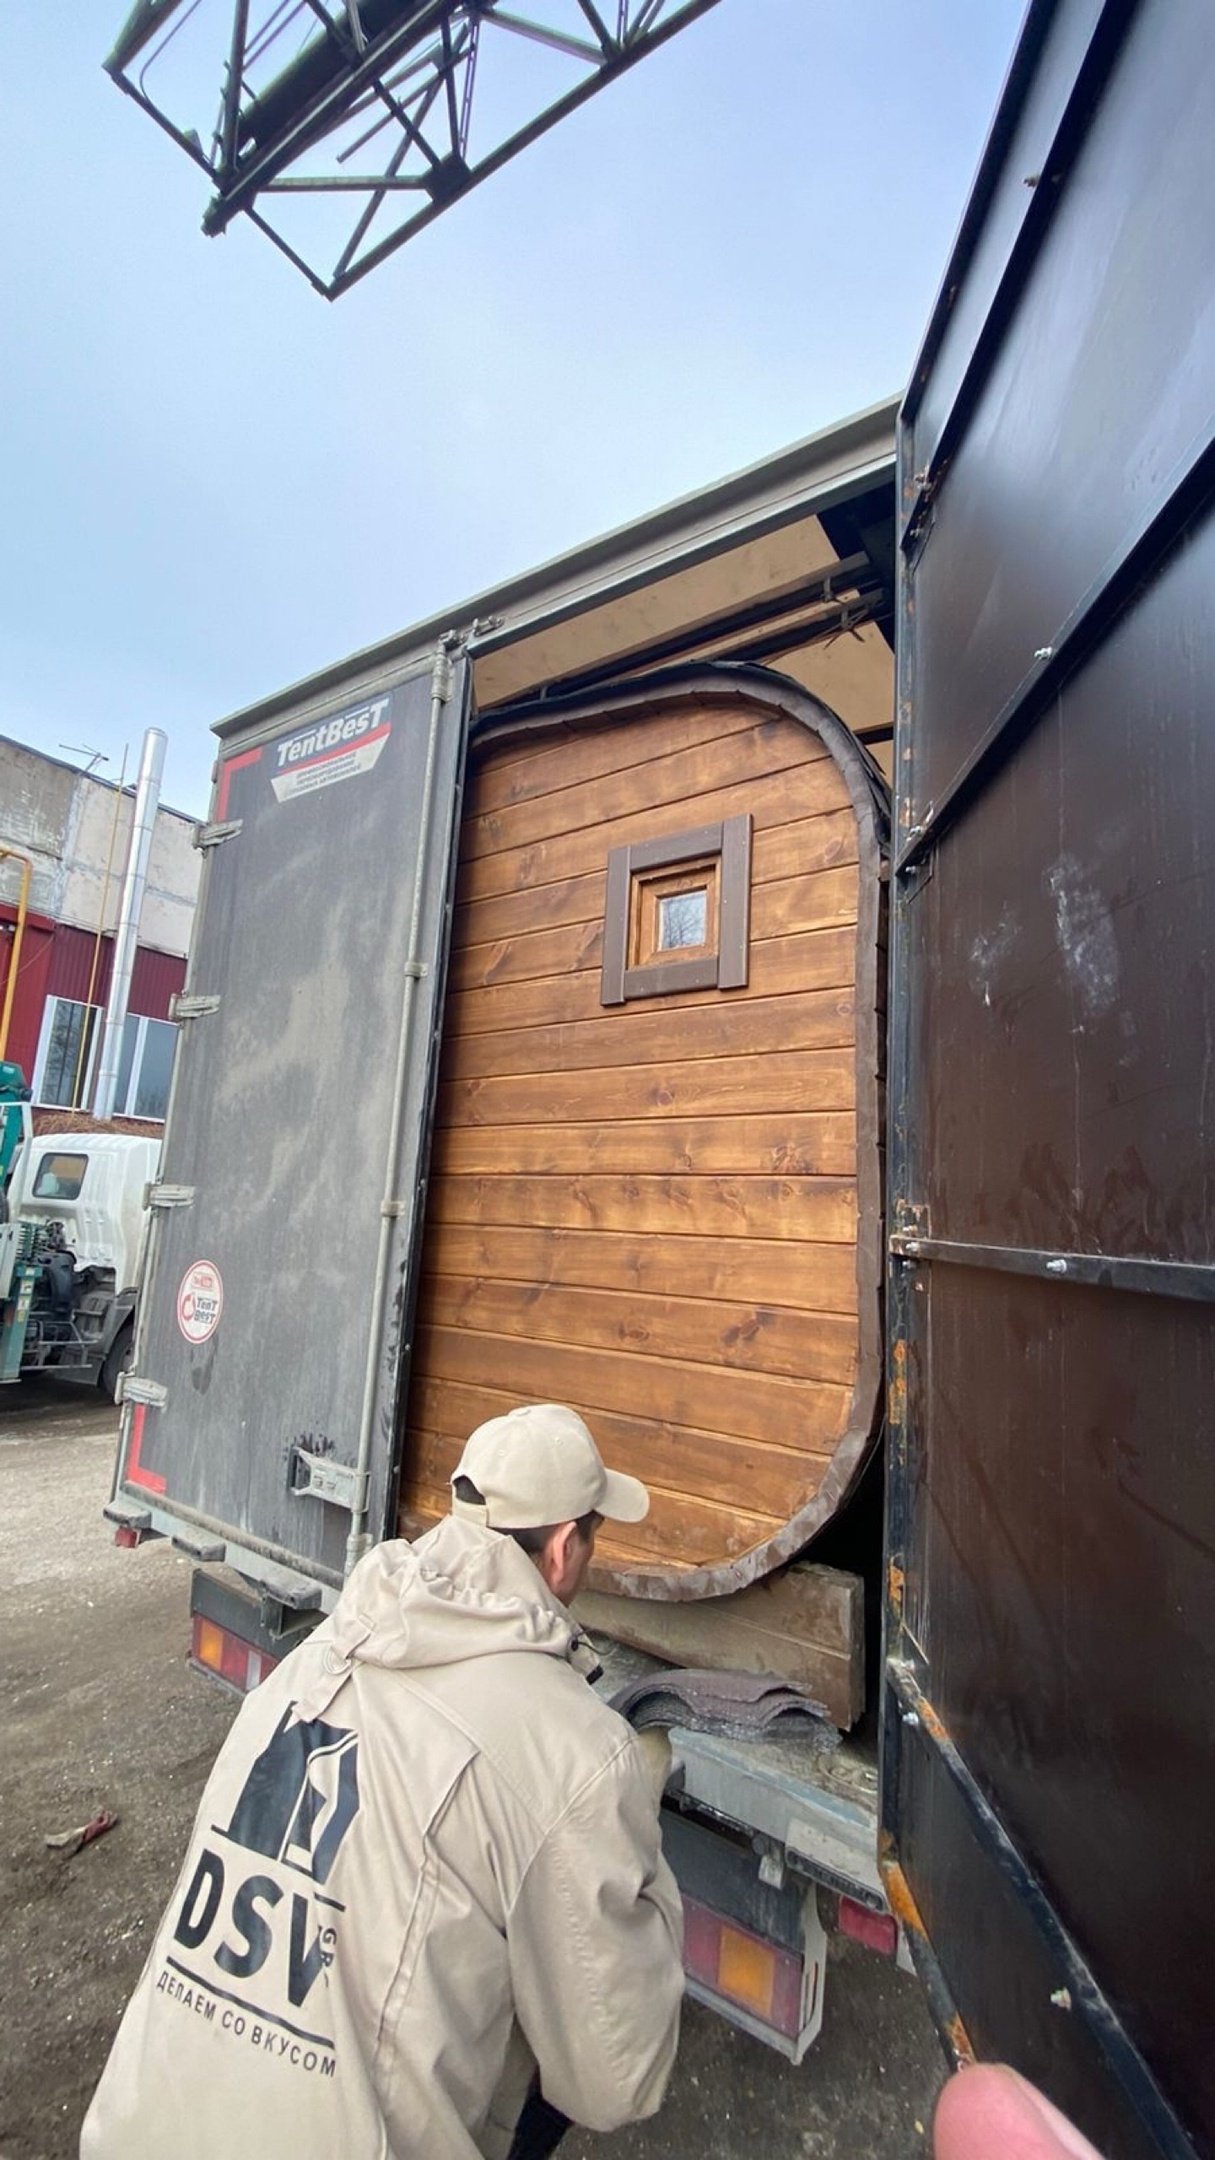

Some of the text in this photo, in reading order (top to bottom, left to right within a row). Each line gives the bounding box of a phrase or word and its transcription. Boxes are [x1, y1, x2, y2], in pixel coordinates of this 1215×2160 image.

[174, 1848, 322, 2008] DSV
[156, 1971, 336, 2078] ДЕЛАЕМ СО ВКУСОМ
